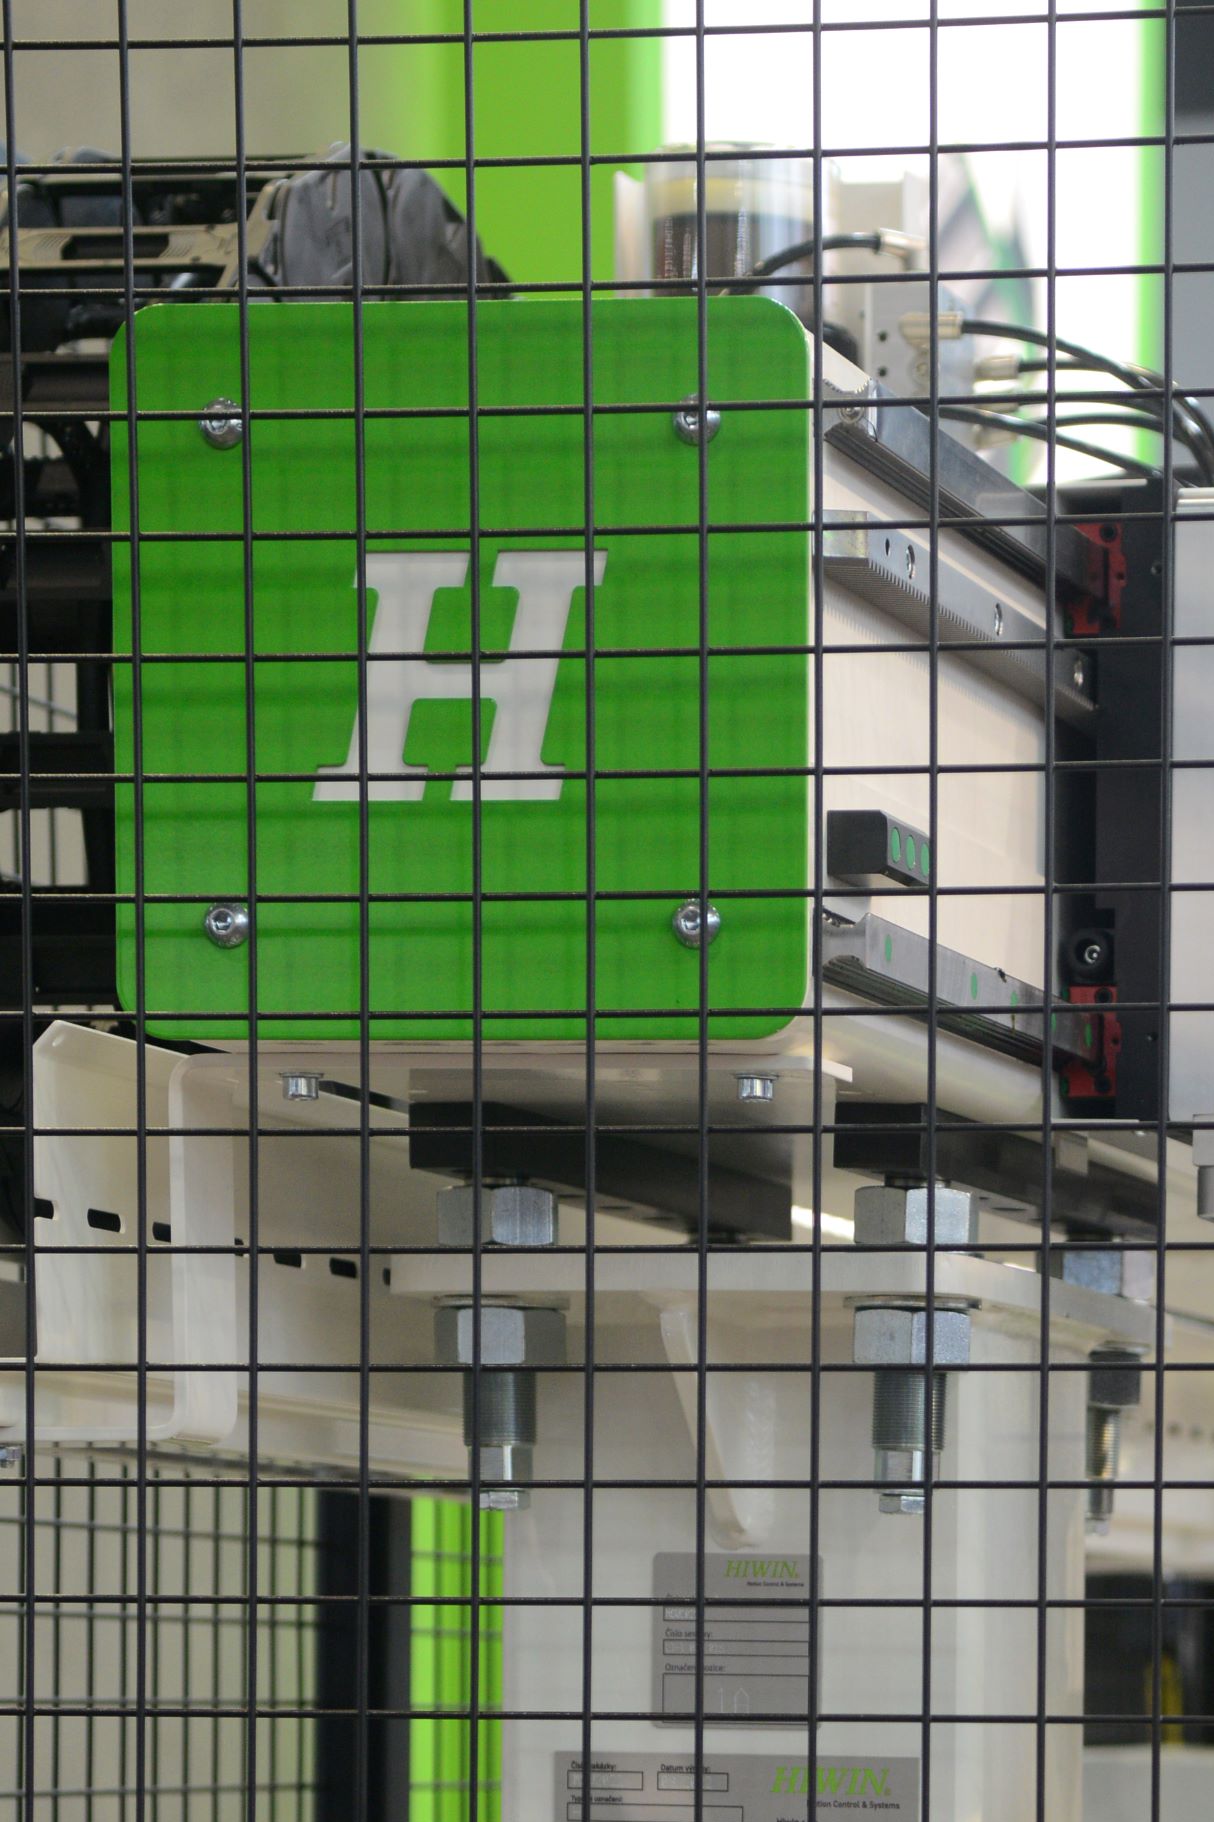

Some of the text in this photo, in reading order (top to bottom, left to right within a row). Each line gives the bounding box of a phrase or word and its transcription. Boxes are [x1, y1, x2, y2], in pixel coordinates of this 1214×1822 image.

[312, 549, 608, 802] H
[724, 1560, 797, 1578] HIWIN
[665, 1663, 699, 1672] Označen
[770, 1765, 888, 1796] HIWIN
[869, 1801, 900, 1810] Systems
